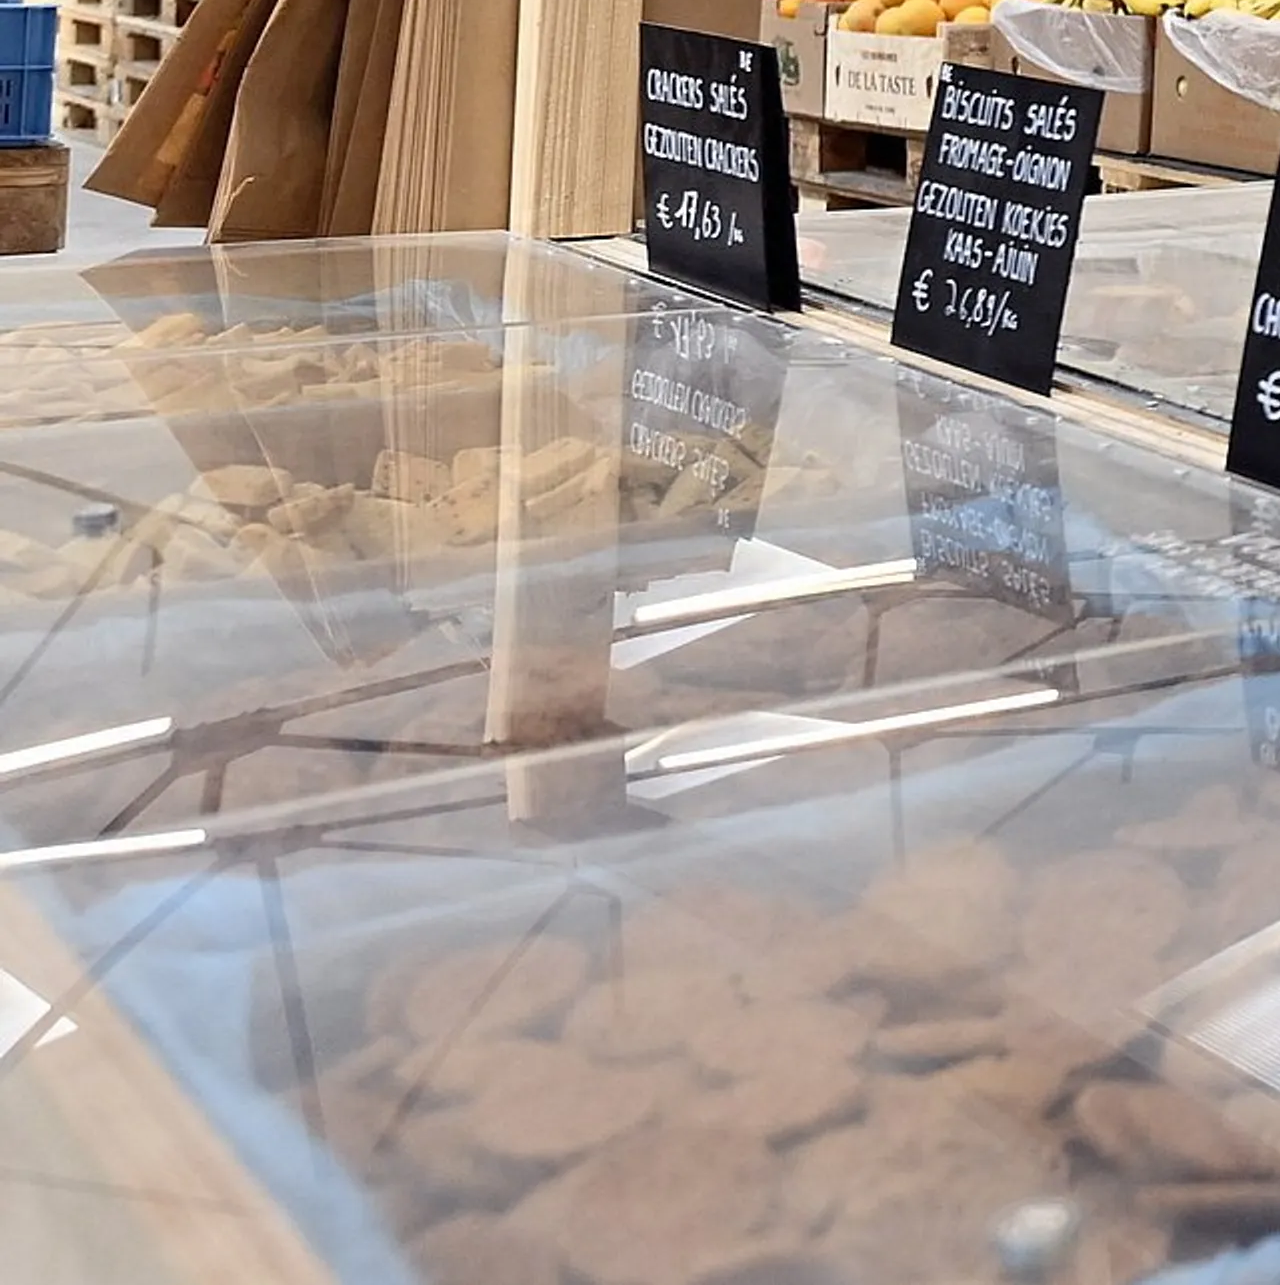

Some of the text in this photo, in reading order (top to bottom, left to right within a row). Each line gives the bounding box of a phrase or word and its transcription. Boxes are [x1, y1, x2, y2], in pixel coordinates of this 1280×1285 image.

[646, 68, 748, 120] CRACKERS SALÉS
[879, 75, 916, 96] TASTE
[1023, 95, 1077, 142] SALÉS
[644, 123, 759, 182] GEZOUTEN CRACKERS
[916, 180, 998, 231] GEZOUTEN
